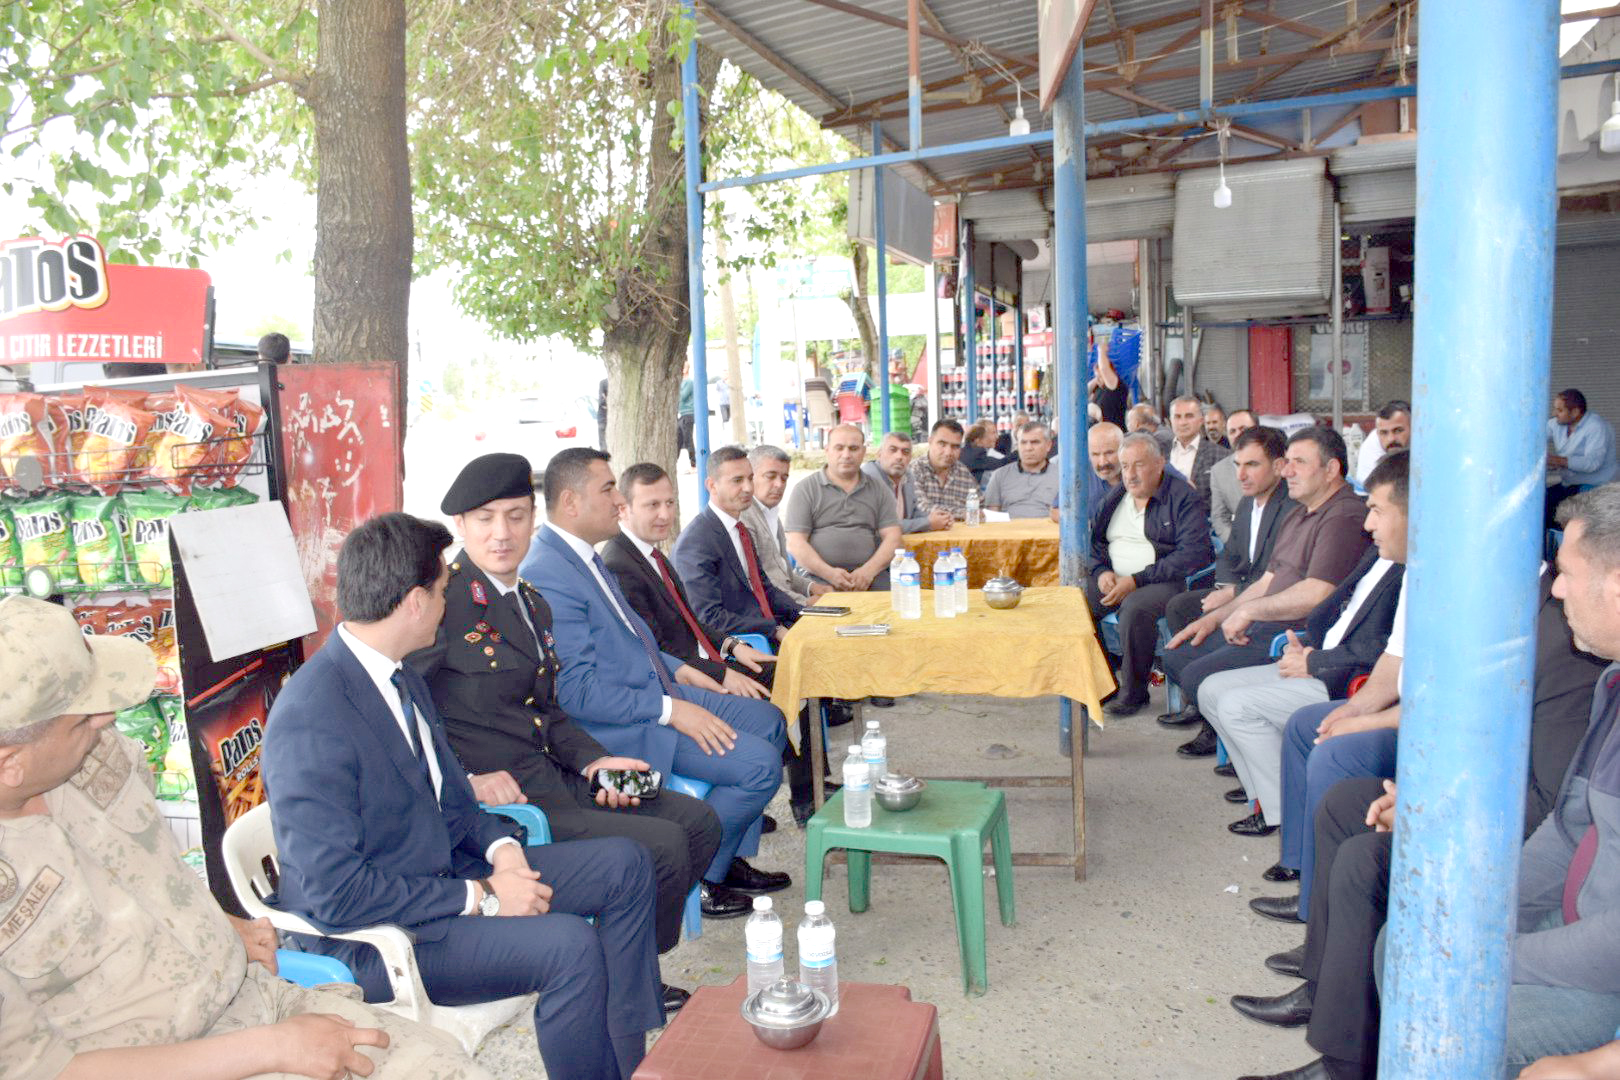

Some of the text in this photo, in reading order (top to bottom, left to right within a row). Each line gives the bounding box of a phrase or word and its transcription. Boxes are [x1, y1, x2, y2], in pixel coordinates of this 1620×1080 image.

[9, 333, 51, 361] ÇITIR
[57, 331, 163, 359] LEZZETLERİ
[2, 882, 49, 939] MEŞALE
